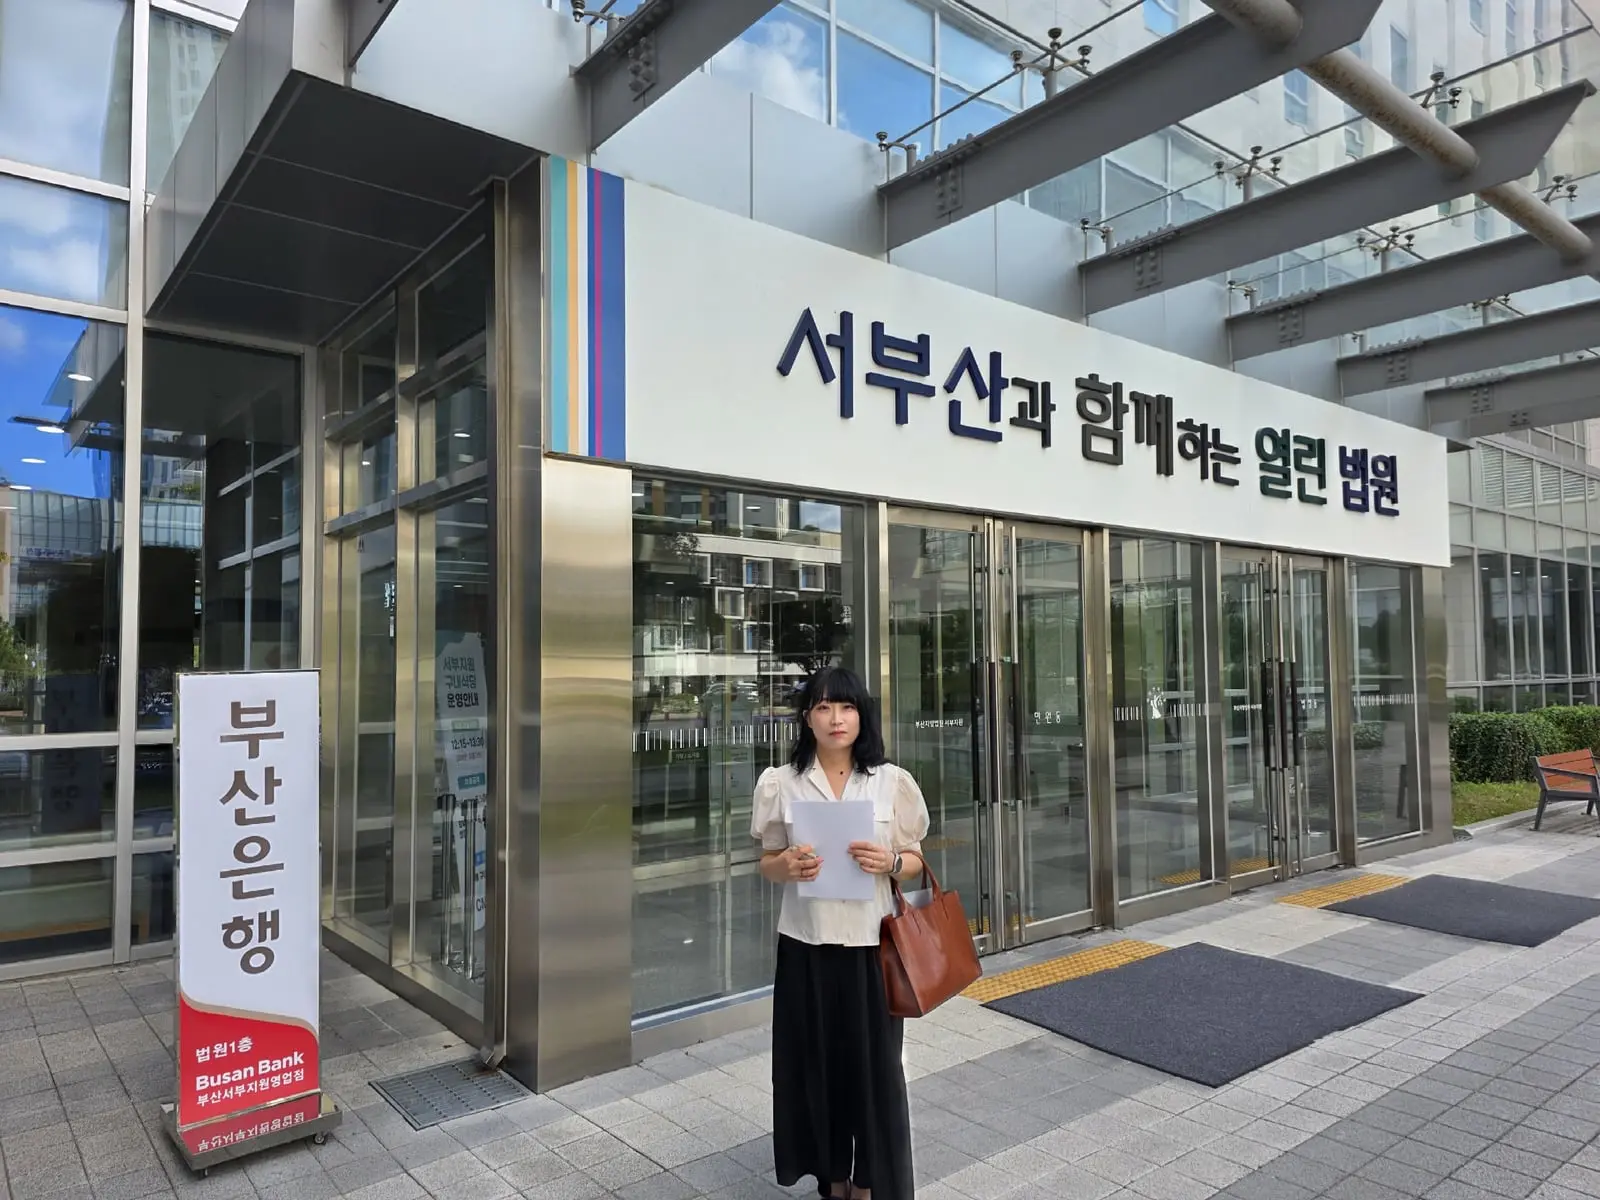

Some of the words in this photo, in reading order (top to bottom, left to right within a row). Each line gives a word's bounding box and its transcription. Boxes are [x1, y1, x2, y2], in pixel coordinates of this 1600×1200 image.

[777, 307, 1056, 448] 서부산과
[1075, 373, 1241, 486] 함께하는
[1255, 427, 1327, 505] 열린
[1339, 446, 1399, 516] 법원
[443, 657, 475, 672] 서부지원
[447, 692, 479, 708] 운영안내
[219, 700, 284, 974] 부산은행
[196, 1036, 253, 1063] 법원1층
[196, 1066, 255, 1091] Busan
[258, 1051, 304, 1075] Bank
[197, 1068, 304, 1107] 부산서부지원영업점
